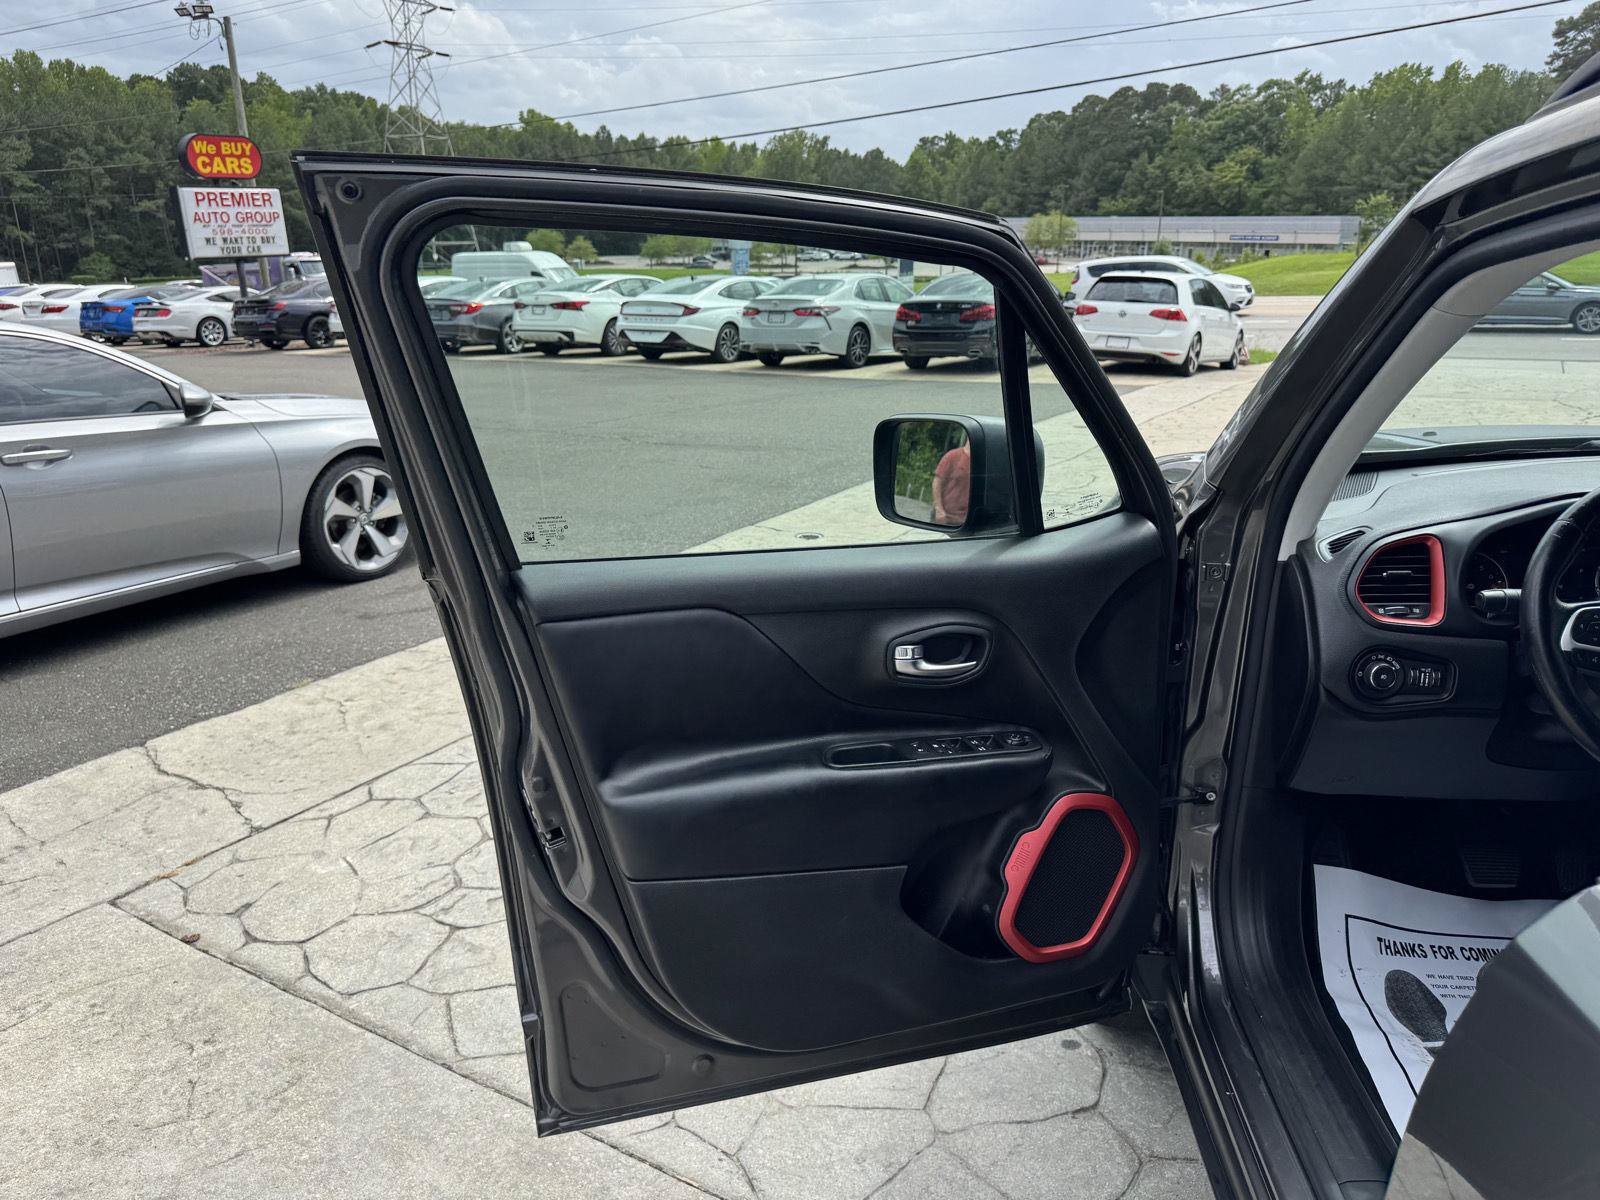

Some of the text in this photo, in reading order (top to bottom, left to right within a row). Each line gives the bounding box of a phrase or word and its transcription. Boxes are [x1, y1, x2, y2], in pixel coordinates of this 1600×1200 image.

[192, 140, 253, 156] We BUY
[196, 156, 254, 174] CARS
[194, 191, 273, 207] PREMIER
[193, 211, 280, 224] AUTO GROUP
[204, 235, 276, 246] WE WANT TO BUY
[220, 245, 263, 255] YOUR CAR
[1376, 936, 1428, 959] THANKS
[1429, 944, 1460, 961] FOR
